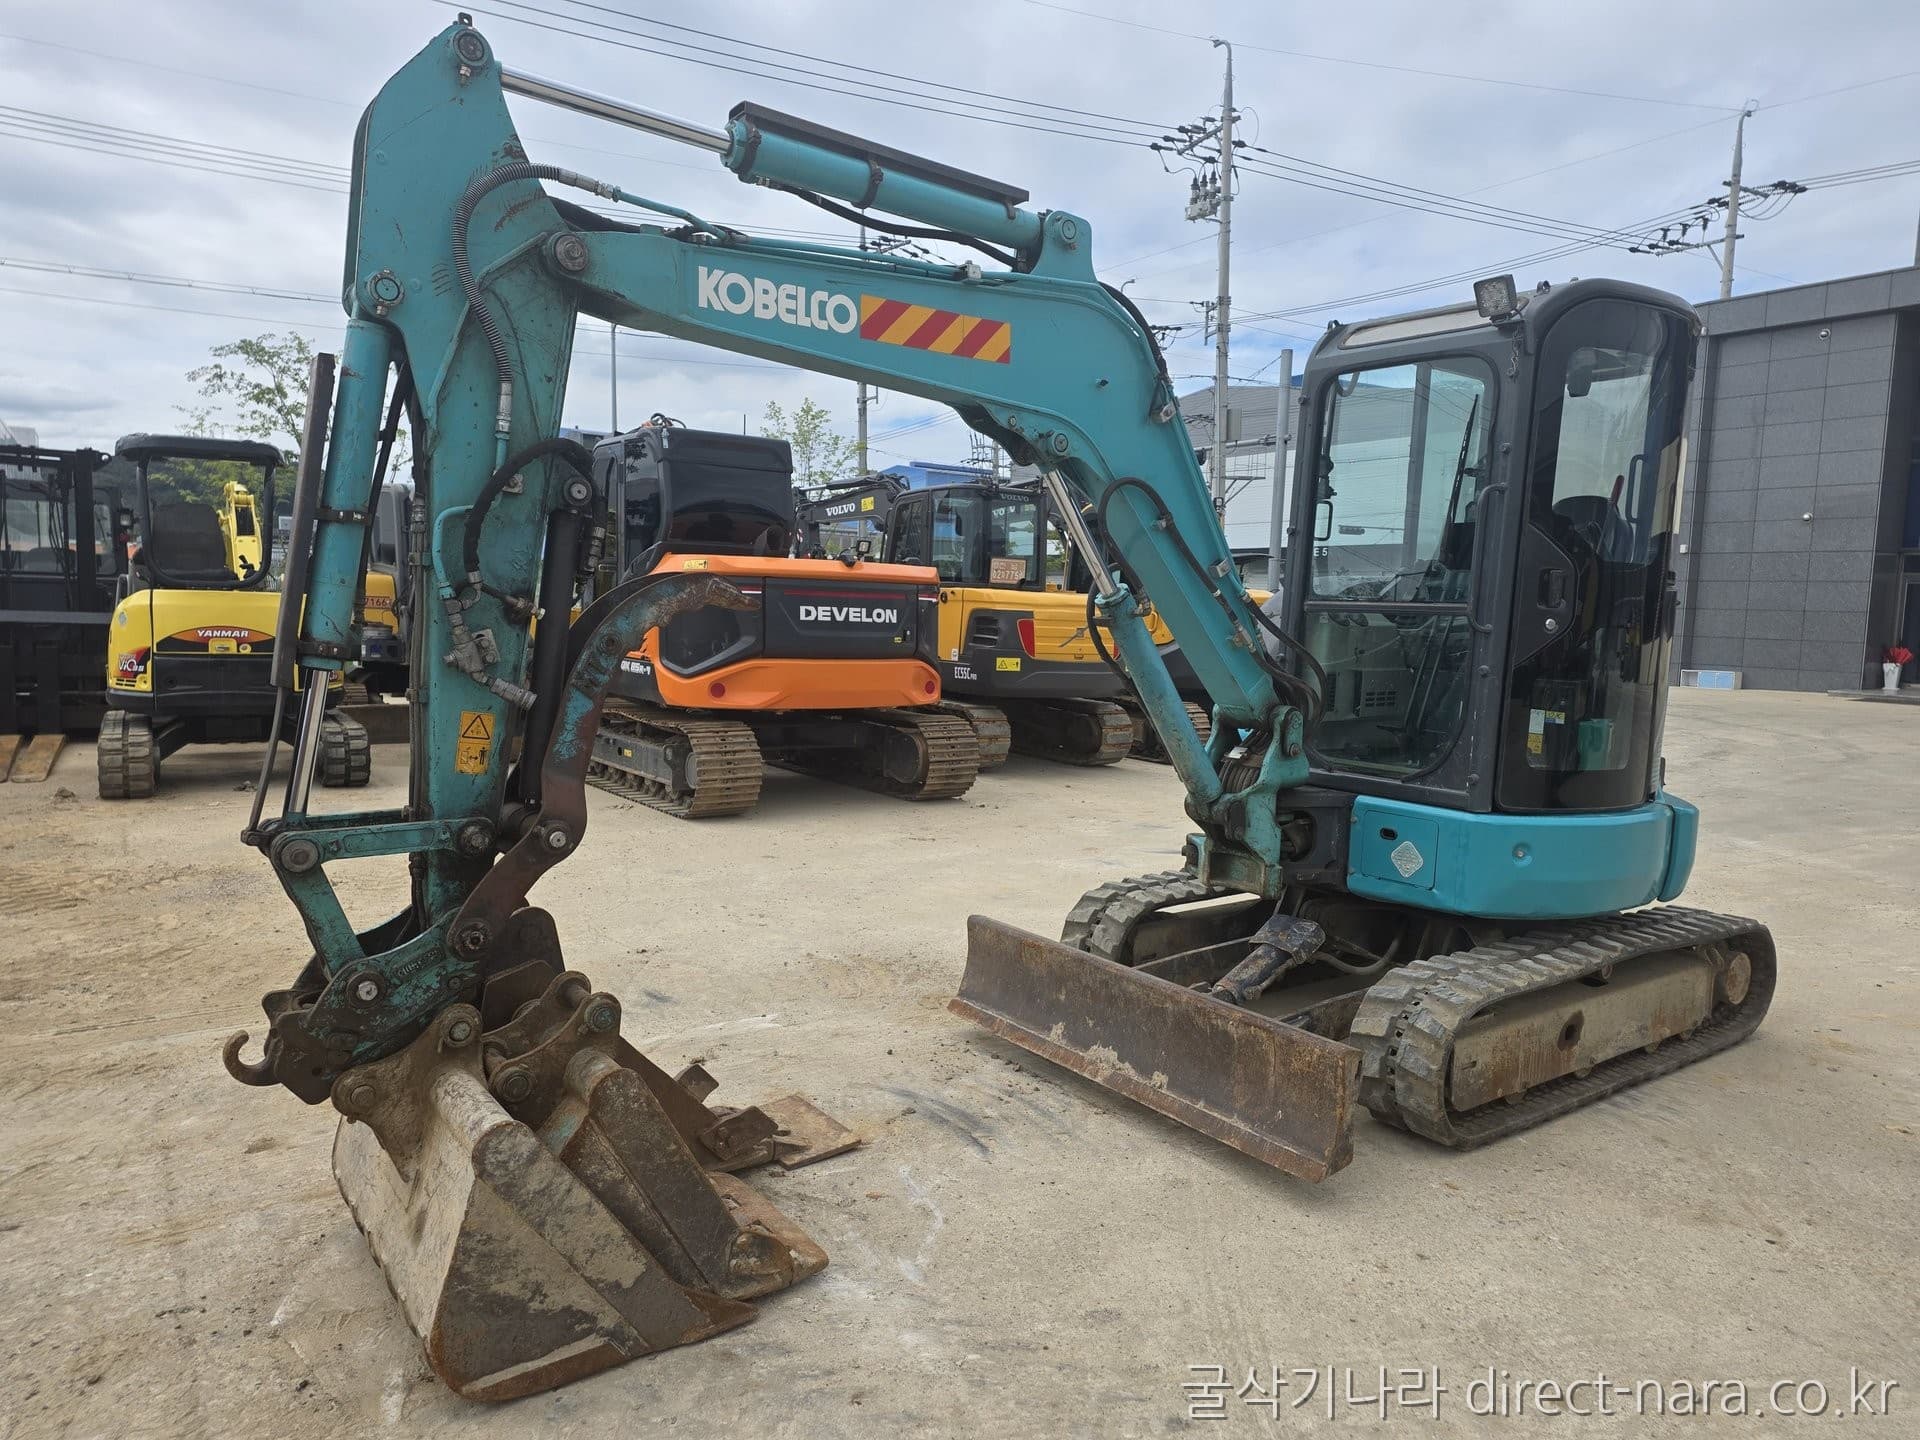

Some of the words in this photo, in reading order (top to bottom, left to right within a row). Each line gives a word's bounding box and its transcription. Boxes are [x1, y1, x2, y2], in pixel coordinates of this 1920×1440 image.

[698, 265, 858, 334] KOBELCO
[826, 502, 856, 516] VOLVO
[799, 605, 898, 624] DEVELON
[197, 629, 249, 638] YANMAR
